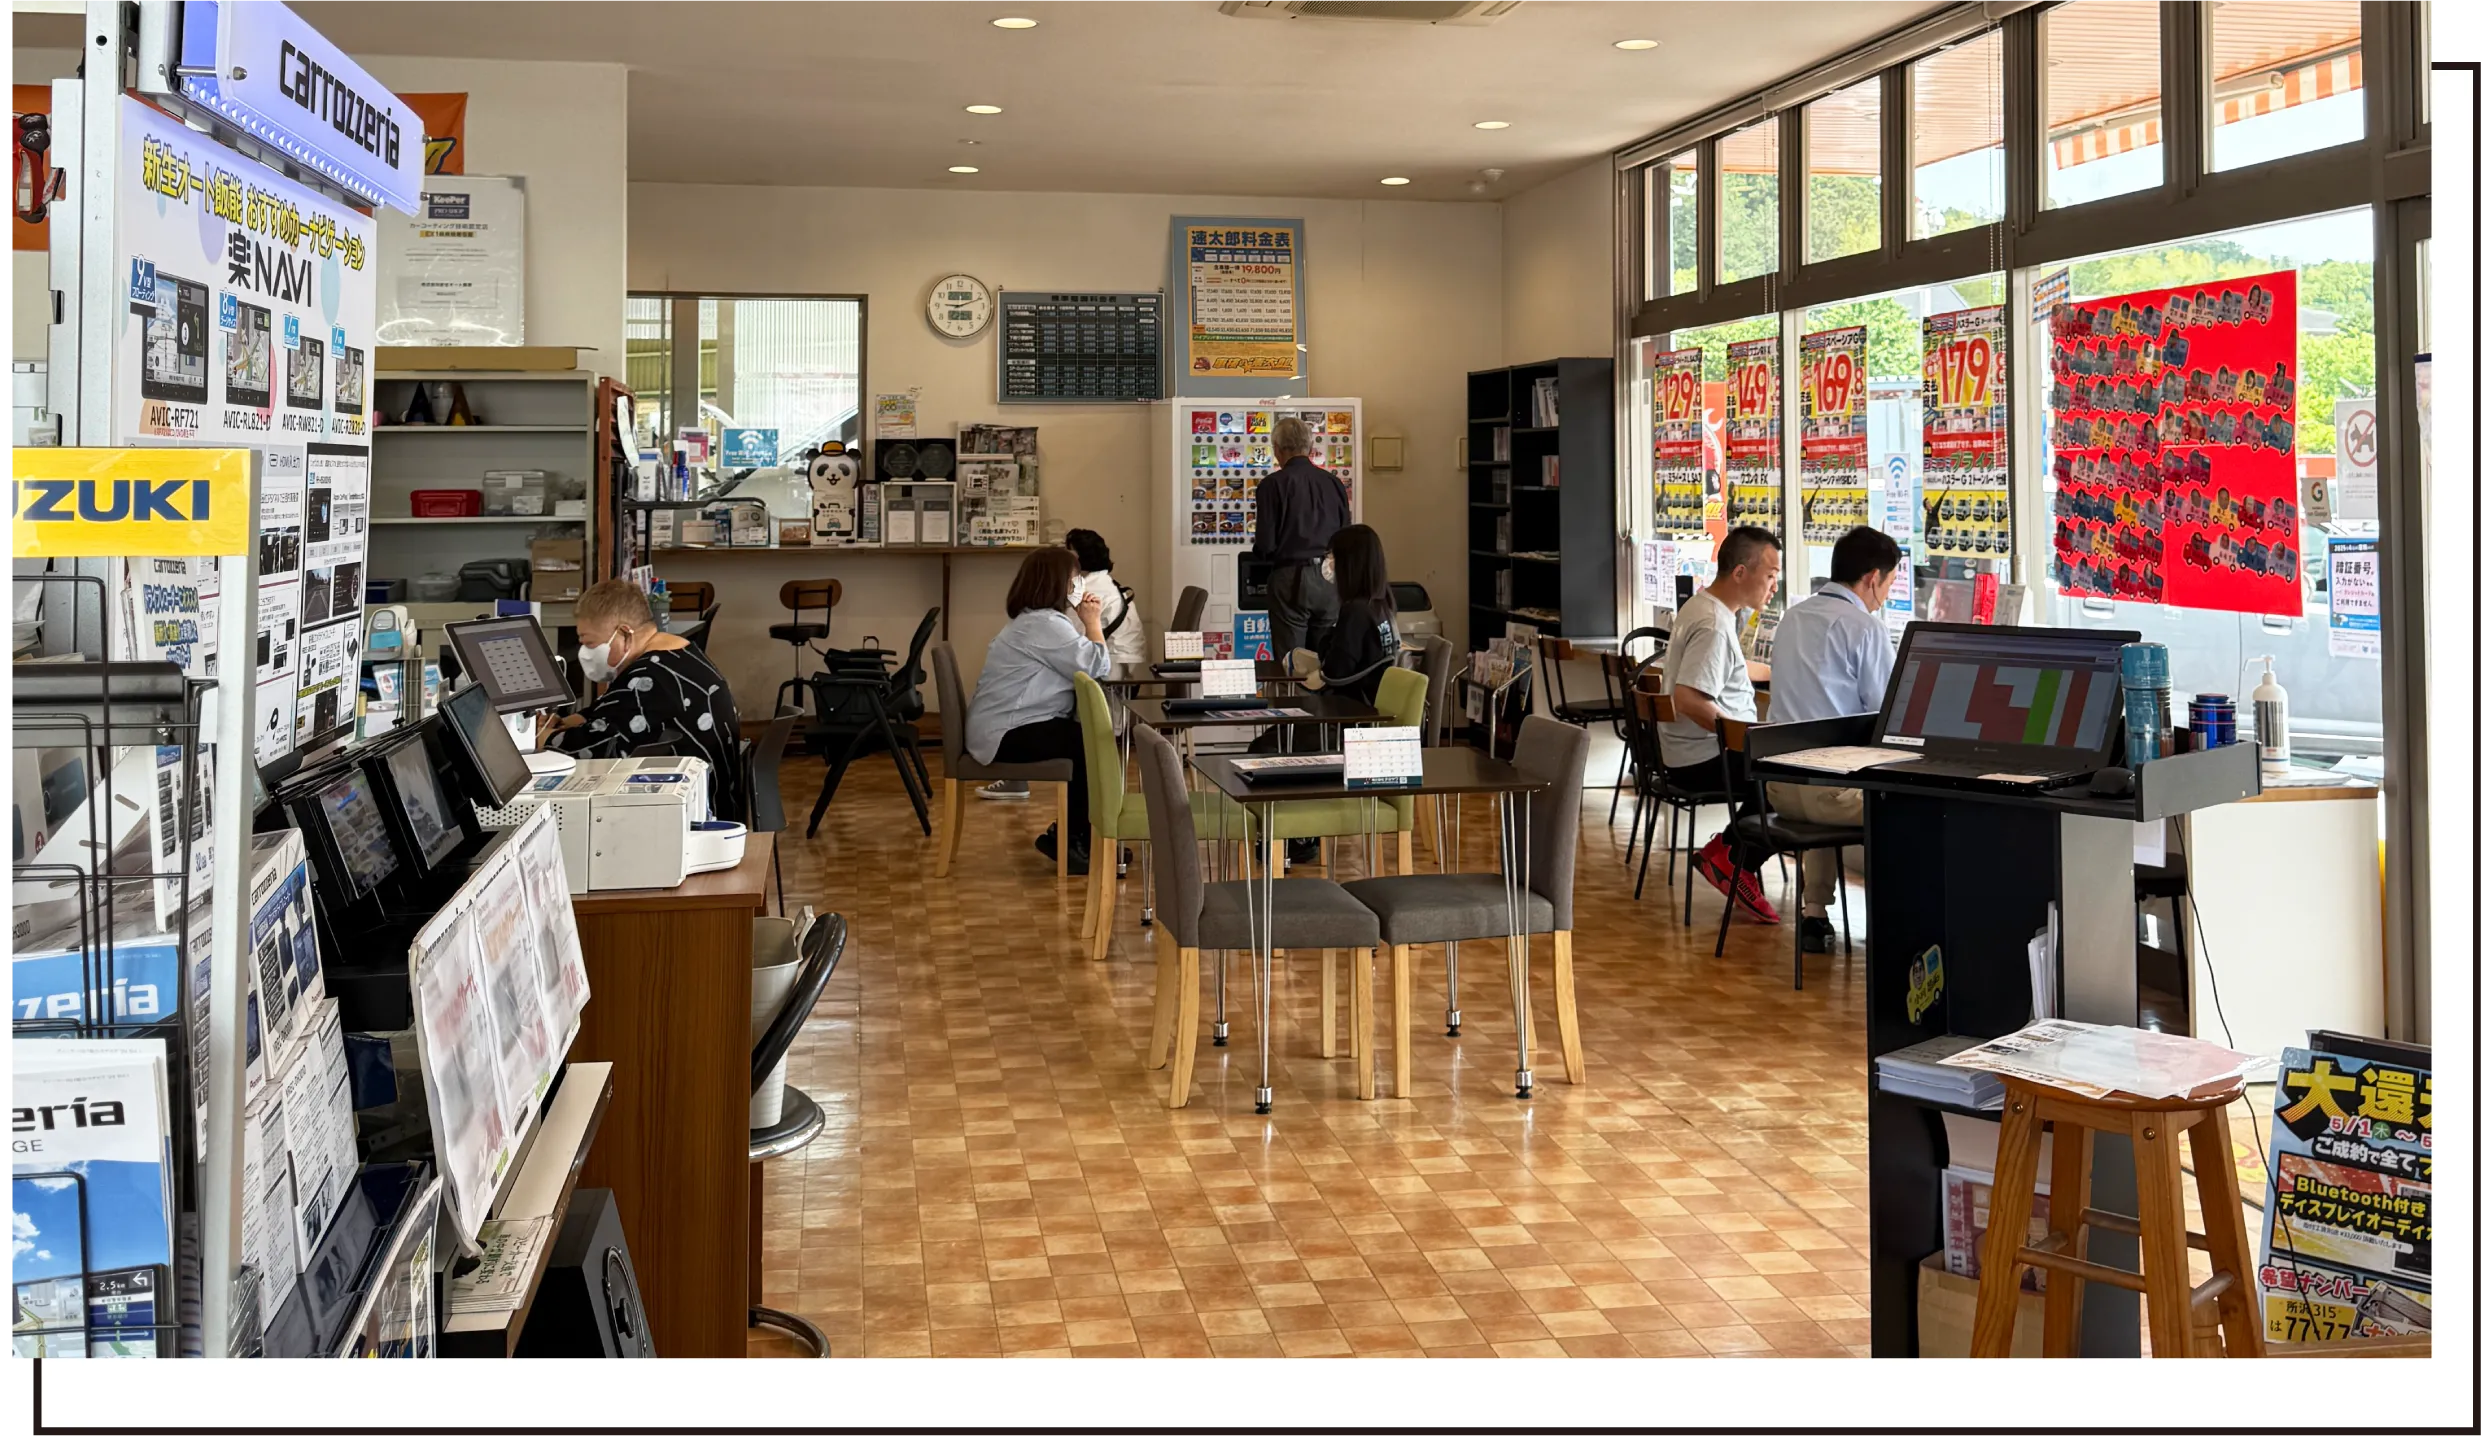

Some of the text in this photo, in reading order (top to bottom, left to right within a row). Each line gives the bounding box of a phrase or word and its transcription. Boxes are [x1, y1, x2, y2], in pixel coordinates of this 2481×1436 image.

[279, 39, 400, 170] carrozzeria
[142, 133, 367, 271] 新生オート飯能 おすすめカーナビゲーション
[1191, 230, 1290, 247] 速太郎料金表
[228, 228, 312, 308] 楽NAVI
[1241, 265, 1281, 274] 19,800円
[150, 406, 199, 428] AVIC-RF721
[12, 480, 210, 522] ZUKI
[154, 558, 186, 574] carrozzeria
[2296, 1177, 2427, 1219] Bluetooth付き
[2260, 1265, 2371, 1299] 希望ナンバー
[2286, 1301, 2337, 1319] 所沢 315
[2270, 1320, 2282, 1333] は
